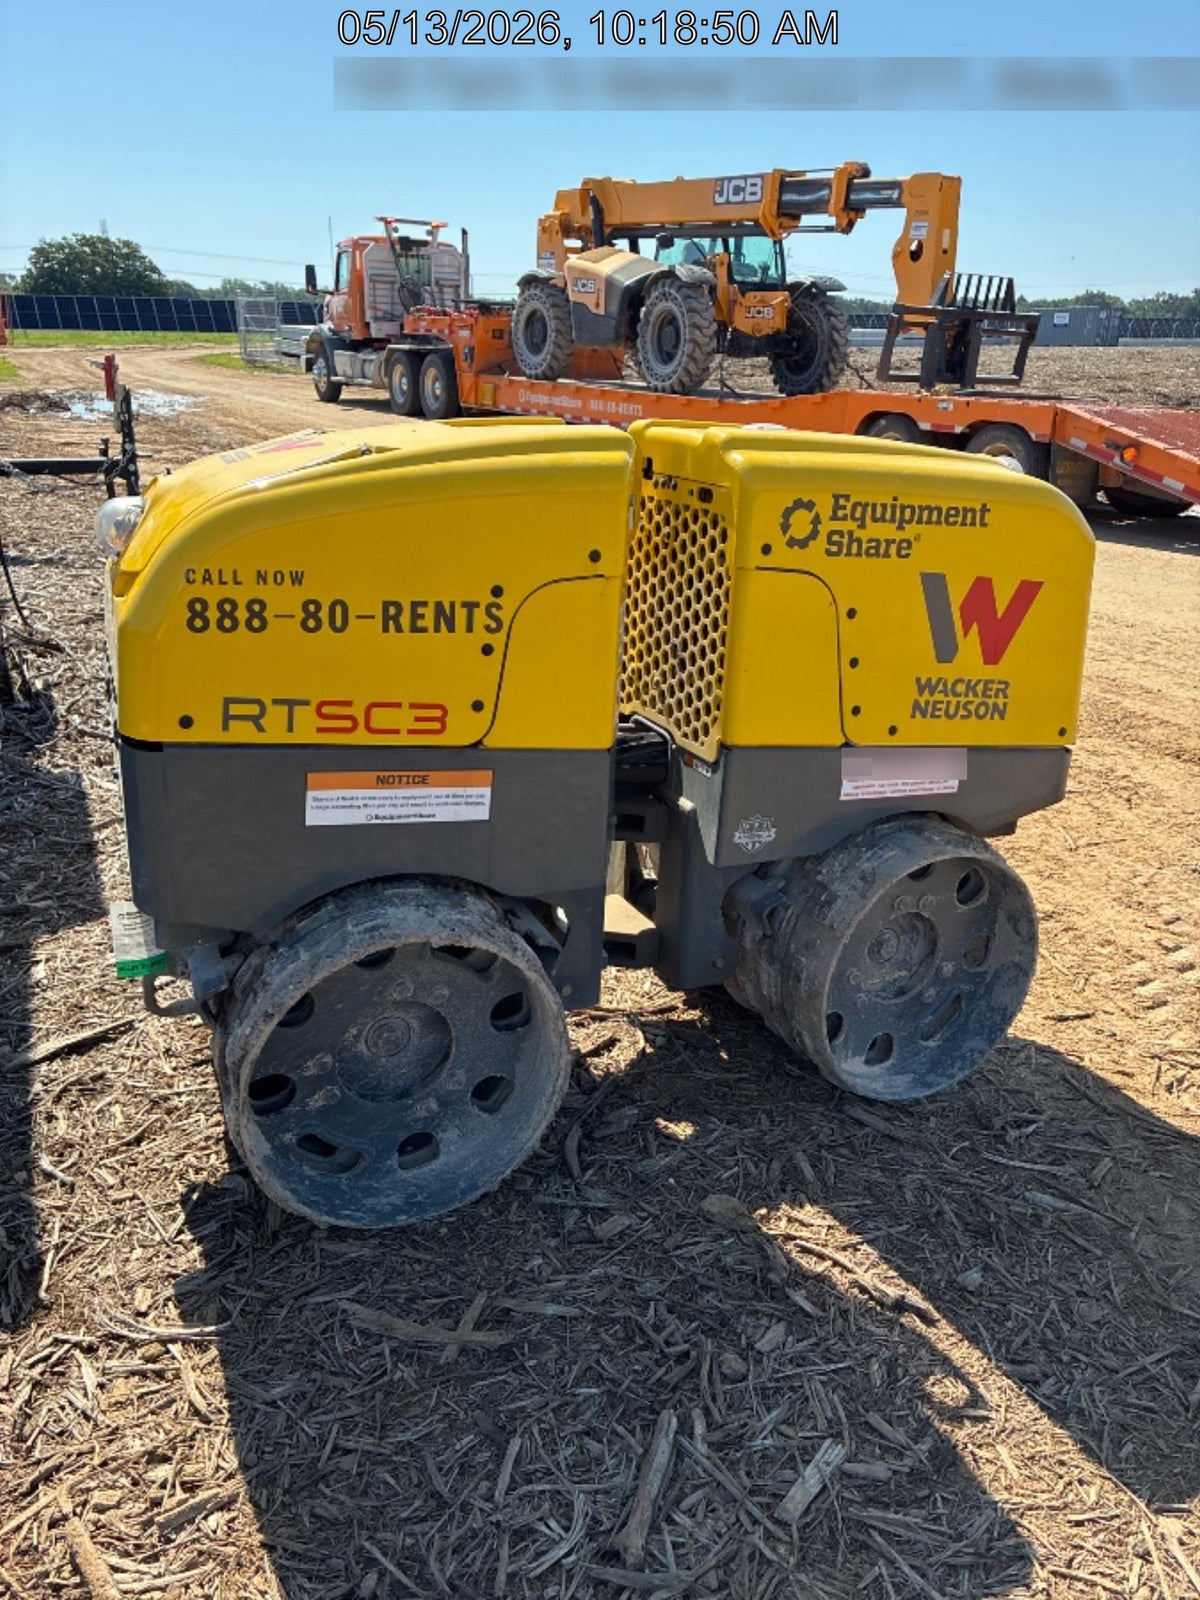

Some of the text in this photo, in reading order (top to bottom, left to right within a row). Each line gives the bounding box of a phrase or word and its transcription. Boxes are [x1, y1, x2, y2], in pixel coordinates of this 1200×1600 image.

[714, 177, 762, 203] JCB
[573, 279, 596, 293] JCB
[746, 305, 774, 319] JCB
[828, 493, 991, 531] Equipment
[184, 568, 305, 586] CALL NOW
[185, 597, 504, 634] 888-80-RENTS
[915, 677, 1010, 699] WACKER
[221, 696, 449, 736] RTSC3
[910, 699, 1008, 721] NEUSON
[375, 774, 430, 786] NOTICE
